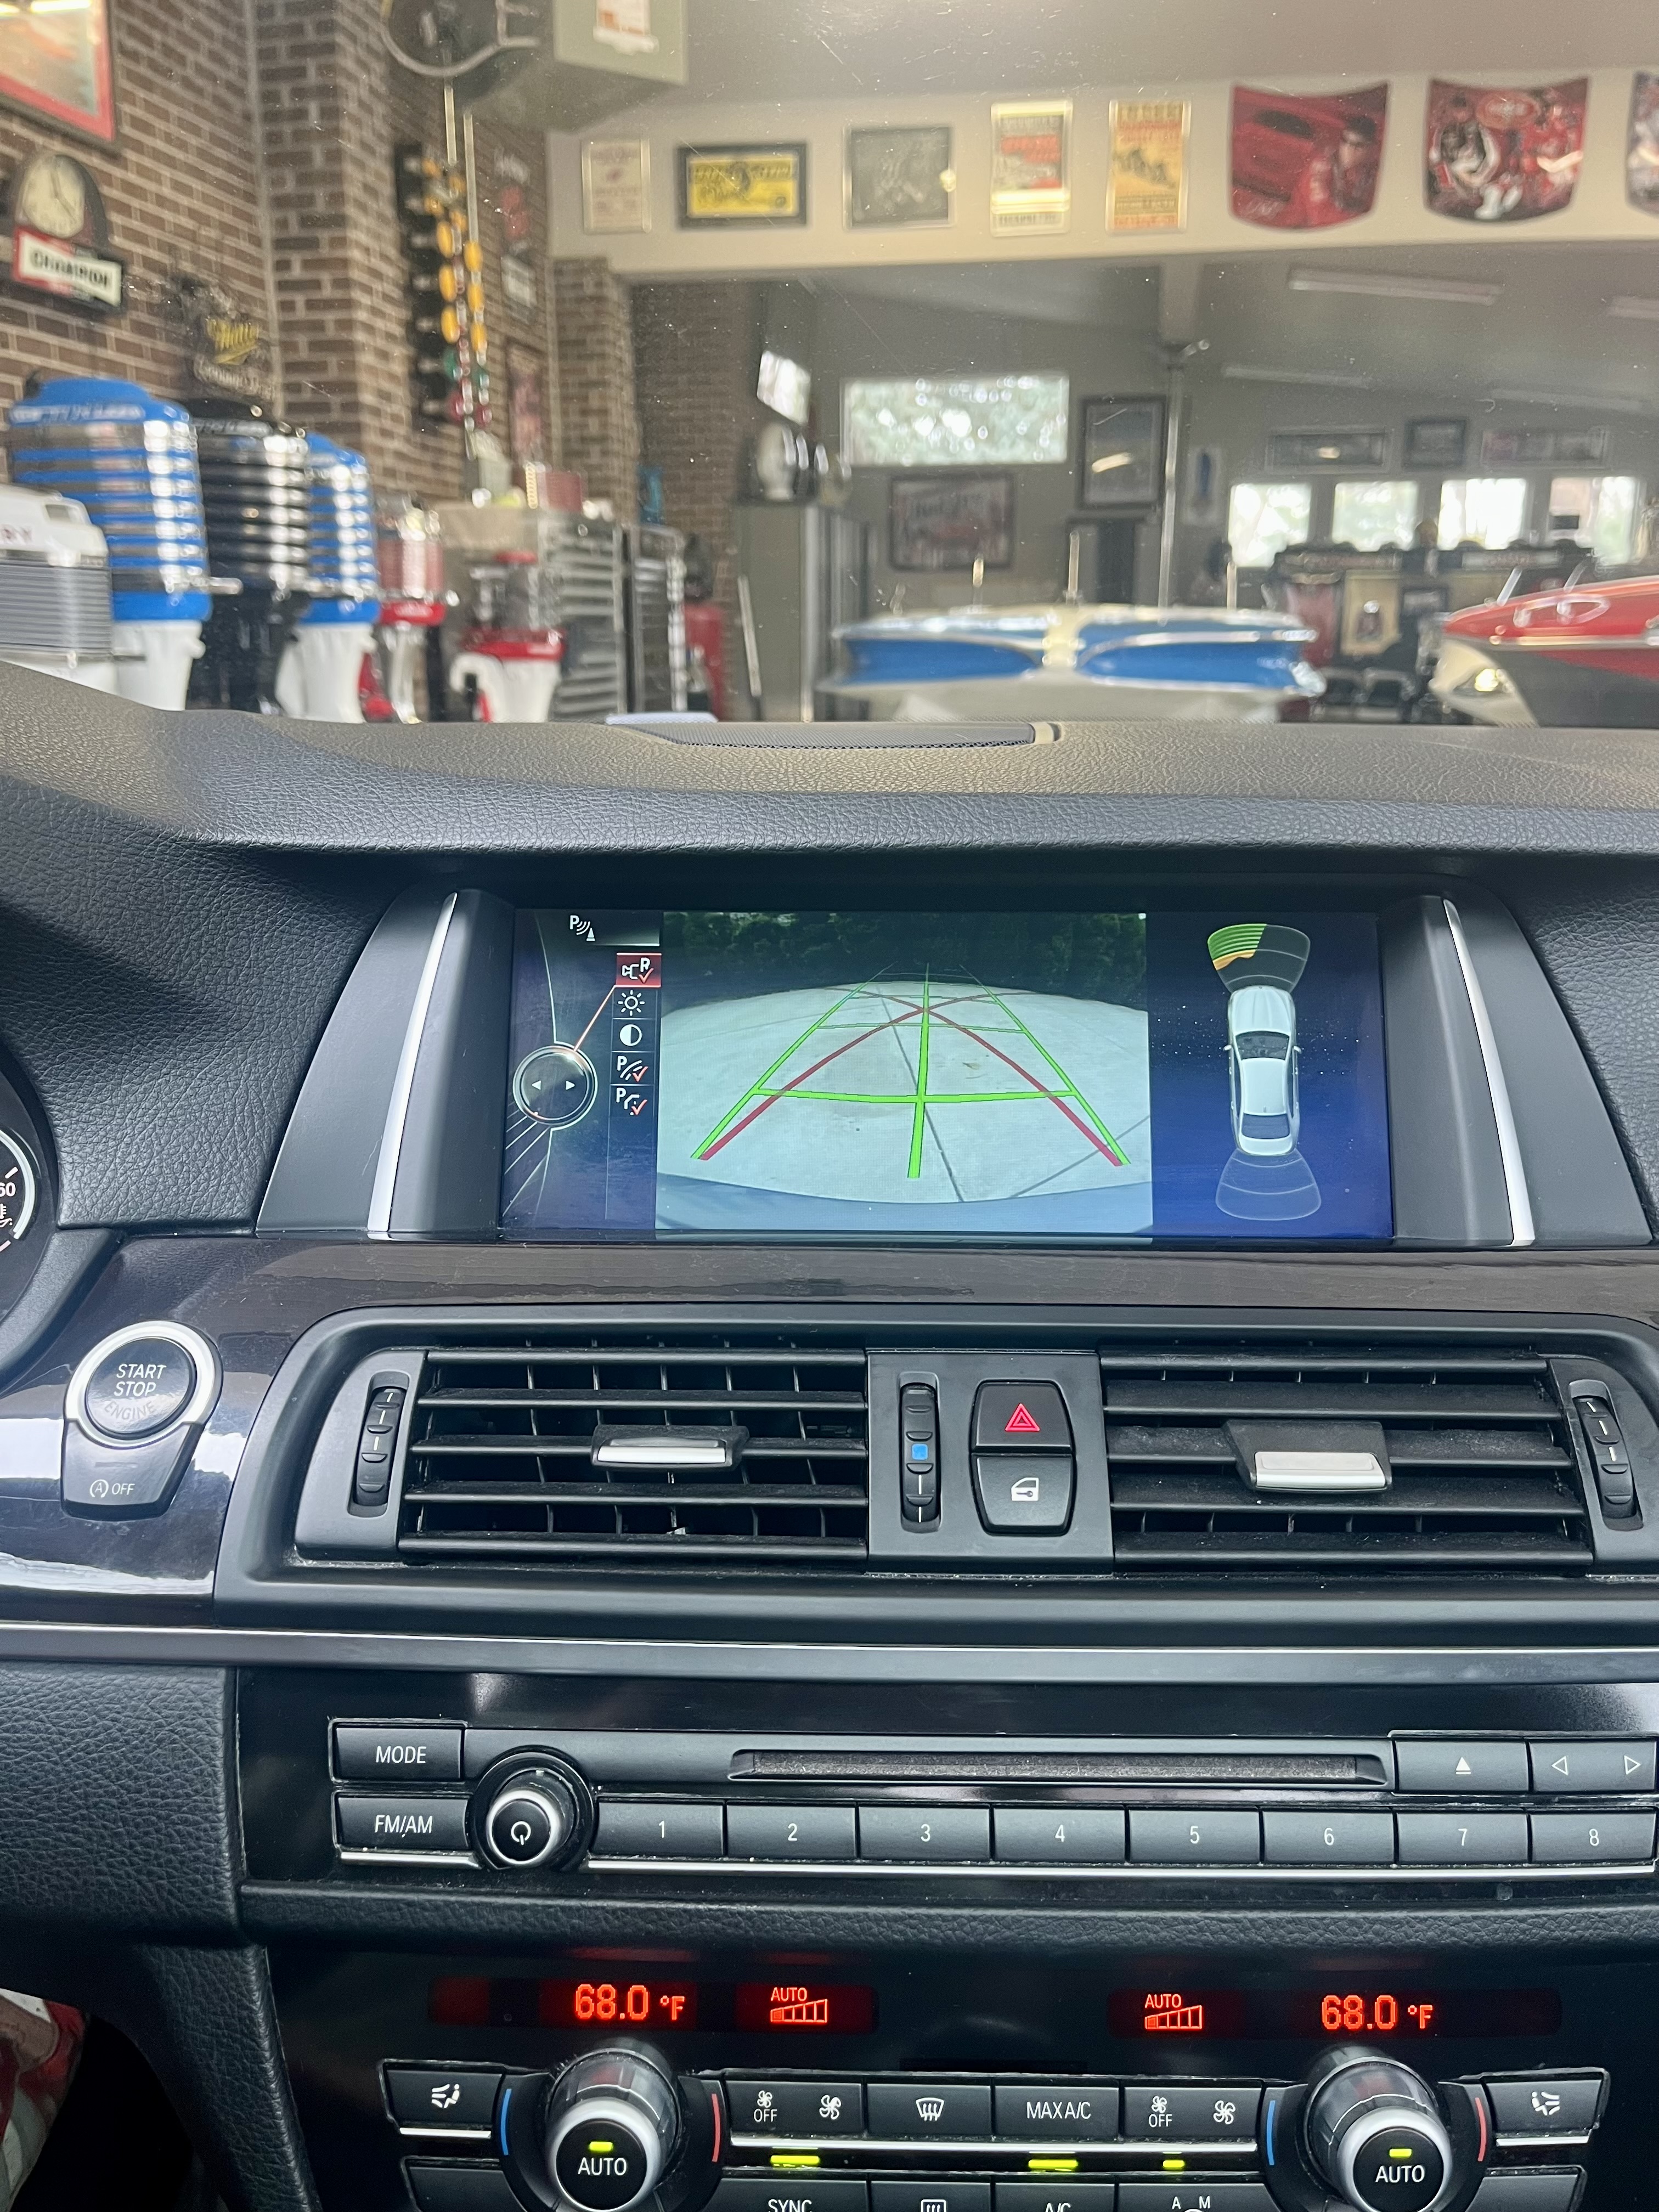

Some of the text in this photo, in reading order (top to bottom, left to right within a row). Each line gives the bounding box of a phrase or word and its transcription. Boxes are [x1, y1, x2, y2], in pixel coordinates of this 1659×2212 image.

[116, 1363, 167, 1379] START
[114, 1380, 156, 1397] STOP
[104, 1400, 156, 1420] ENGINE
[111, 1482, 136, 1496] OFF
[375, 1745, 426, 1764] MODE
[374, 1814, 433, 1835] FM/AM
[657, 1820, 666, 1838] 1
[787, 1823, 798, 1842] 2
[920, 1824, 932, 1842] 3
[1054, 1824, 1066, 1843] 4
[1189, 1825, 1200, 1845] 5
[1323, 1827, 1335, 1846] 6
[1457, 1828, 1468, 1846] 7
[1589, 1828, 1600, 1846] 8
[574, 1984, 650, 2021] 68.0
[770, 1987, 808, 2002] AUTO
[1144, 1993, 1182, 2009] AUTO
[1322, 1995, 1398, 2031] 68.0
[753, 2108, 777, 2123] OFF
[1026, 2101, 1091, 2119] MAX A/C
[1148, 2114, 1173, 2128] OFF
[578, 2157, 628, 2176] AUTO
[1375, 2165, 1425, 2183] AUTO
[768, 2199, 812, 2212] SYNC
[1172, 2196, 1211, 2210] A M
